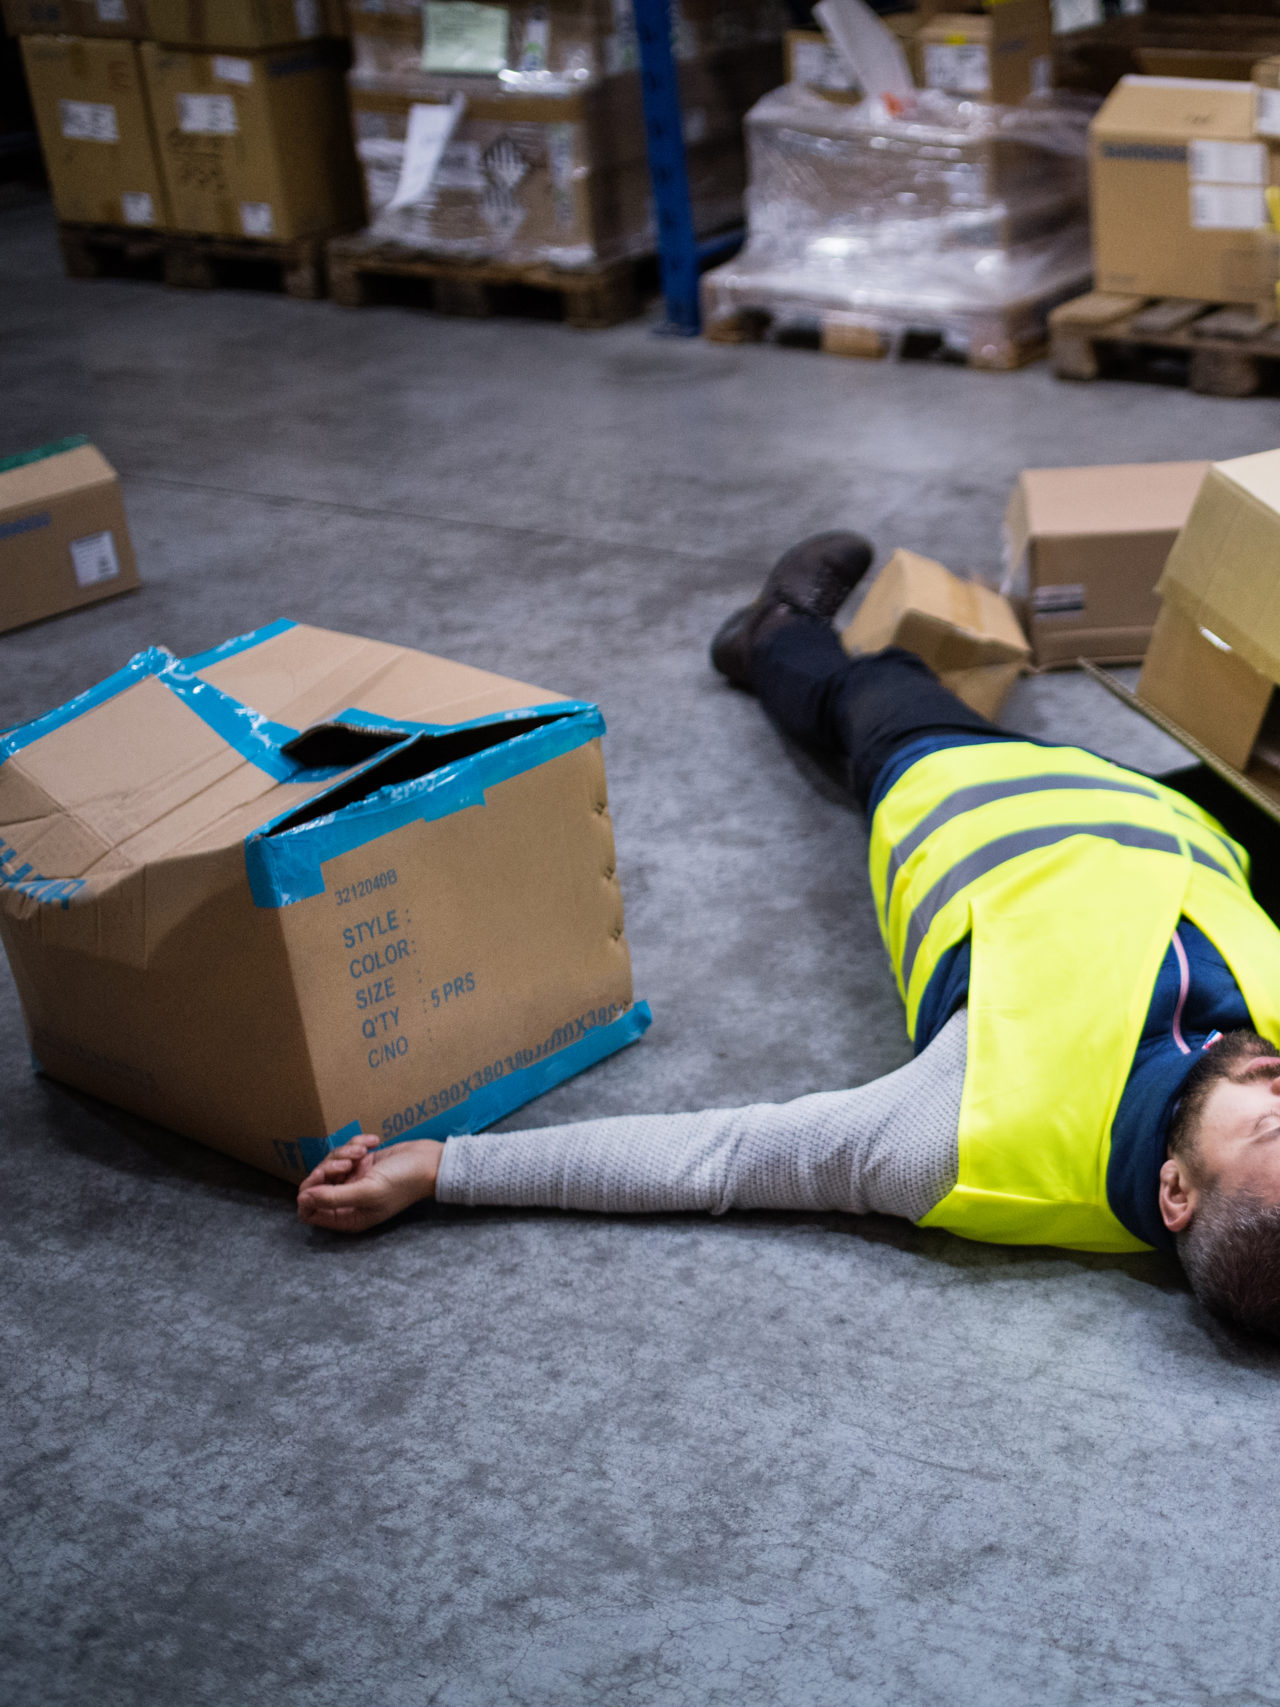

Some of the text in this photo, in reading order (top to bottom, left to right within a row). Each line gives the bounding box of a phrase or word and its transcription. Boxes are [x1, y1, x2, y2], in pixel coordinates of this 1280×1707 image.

[355, 977, 396, 1010] SIZE
[362, 1007, 399, 1039] Q'TY
[368, 1035, 409, 1069] C/NO
